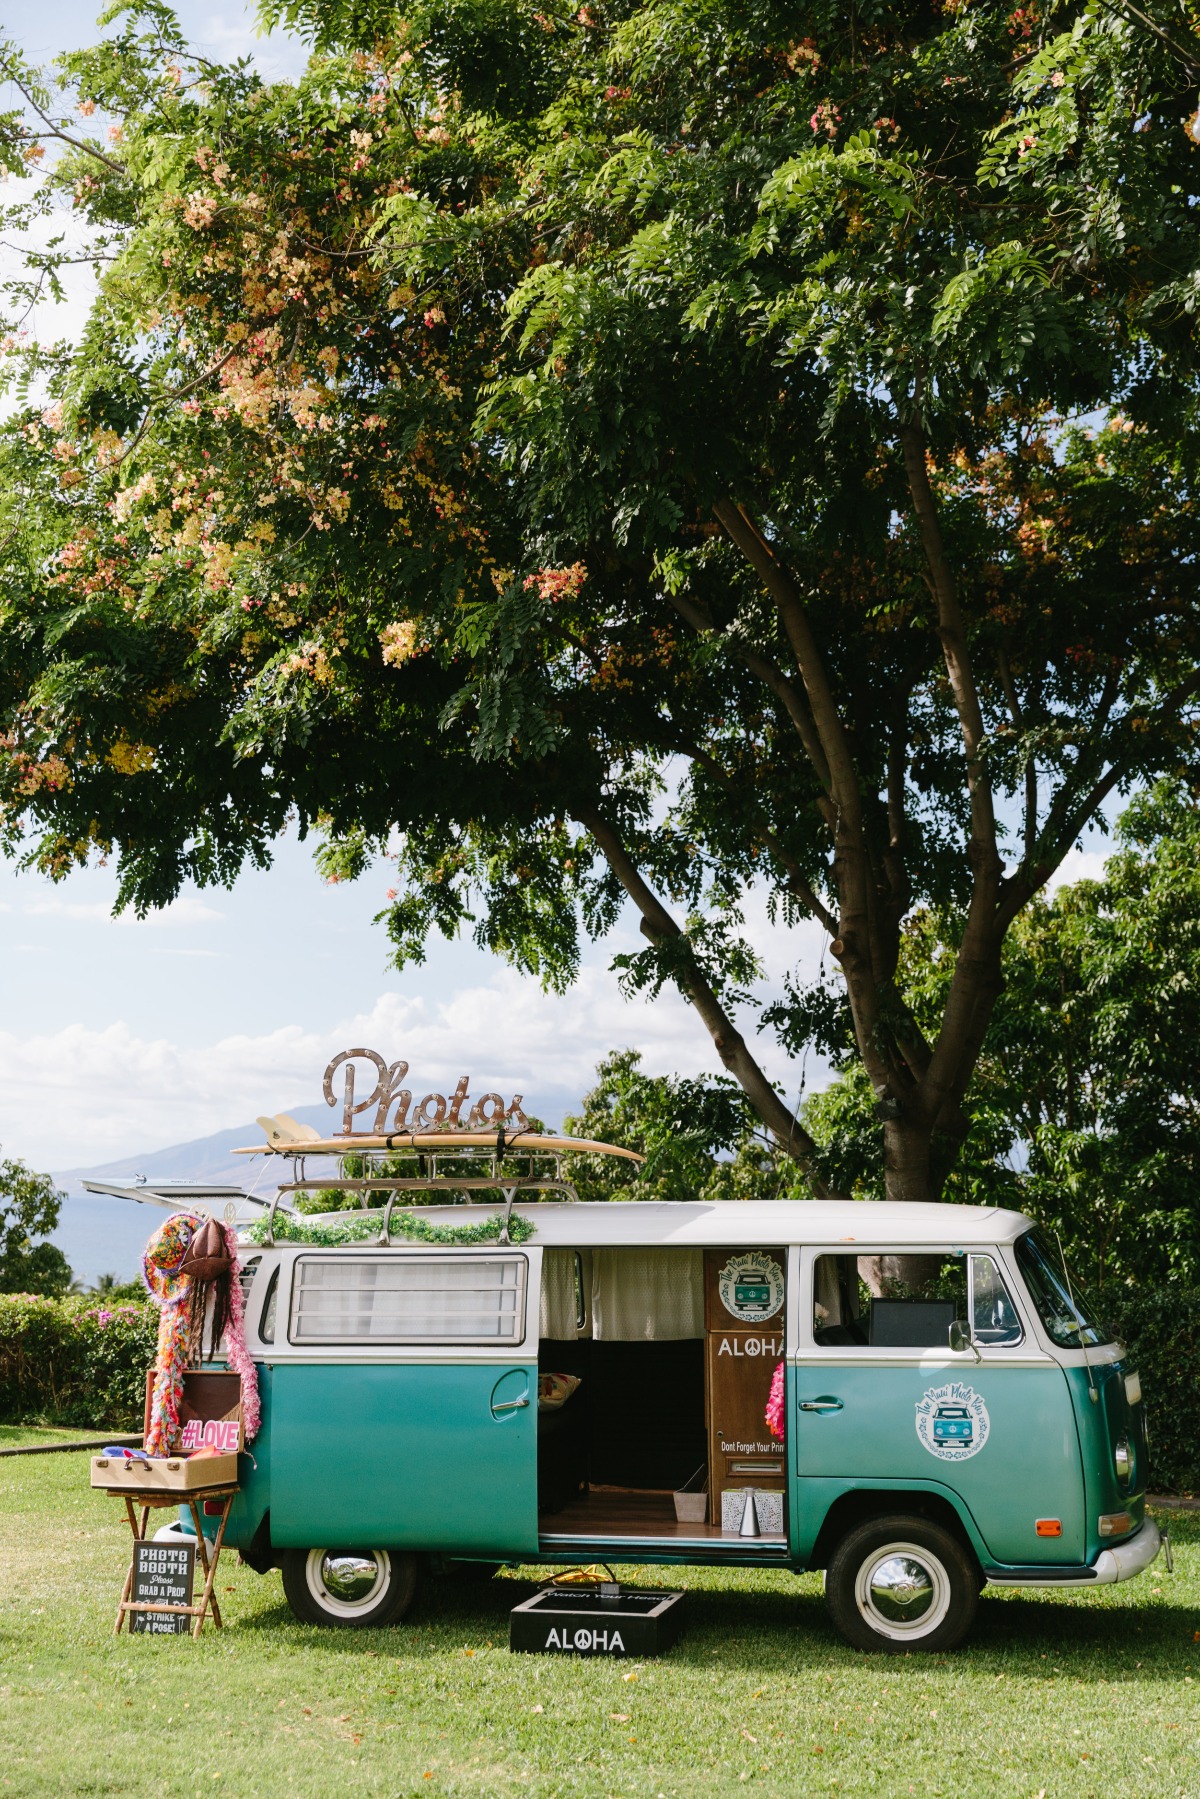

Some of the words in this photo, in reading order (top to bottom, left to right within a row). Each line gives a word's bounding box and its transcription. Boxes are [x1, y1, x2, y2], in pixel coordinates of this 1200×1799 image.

[322, 1047, 531, 1134] Photos
[719, 1268, 734, 1282] The
[728, 1255, 749, 1270] Maui
[751, 1252, 770, 1270] Photo
[916, 1400, 933, 1416] The
[925, 1386, 948, 1403] Maui
[951, 1383, 973, 1402] Photo
[182, 1420, 239, 1450] #LOVE
[721, 1441, 736, 1452] Dont
[736, 1441, 756, 1454] Forget
[756, 1442, 771, 1453] Your
[771, 1442, 784, 1453] Prin
[139, 1548, 188, 1563] PHOTO
[139, 1561, 188, 1575] BOOTH
[150, 1574, 174, 1584] Please
[139, 1584, 158, 1596] GRAB
[159, 1586, 165, 1596] A
[167, 1586, 185, 1597] PROP
[146, 1612, 175, 1622] STRIKE
[146, 1622, 151, 1632] A
[152, 1622, 176, 1633] POSE!
[545, 1627, 625, 1652] ALOHA
